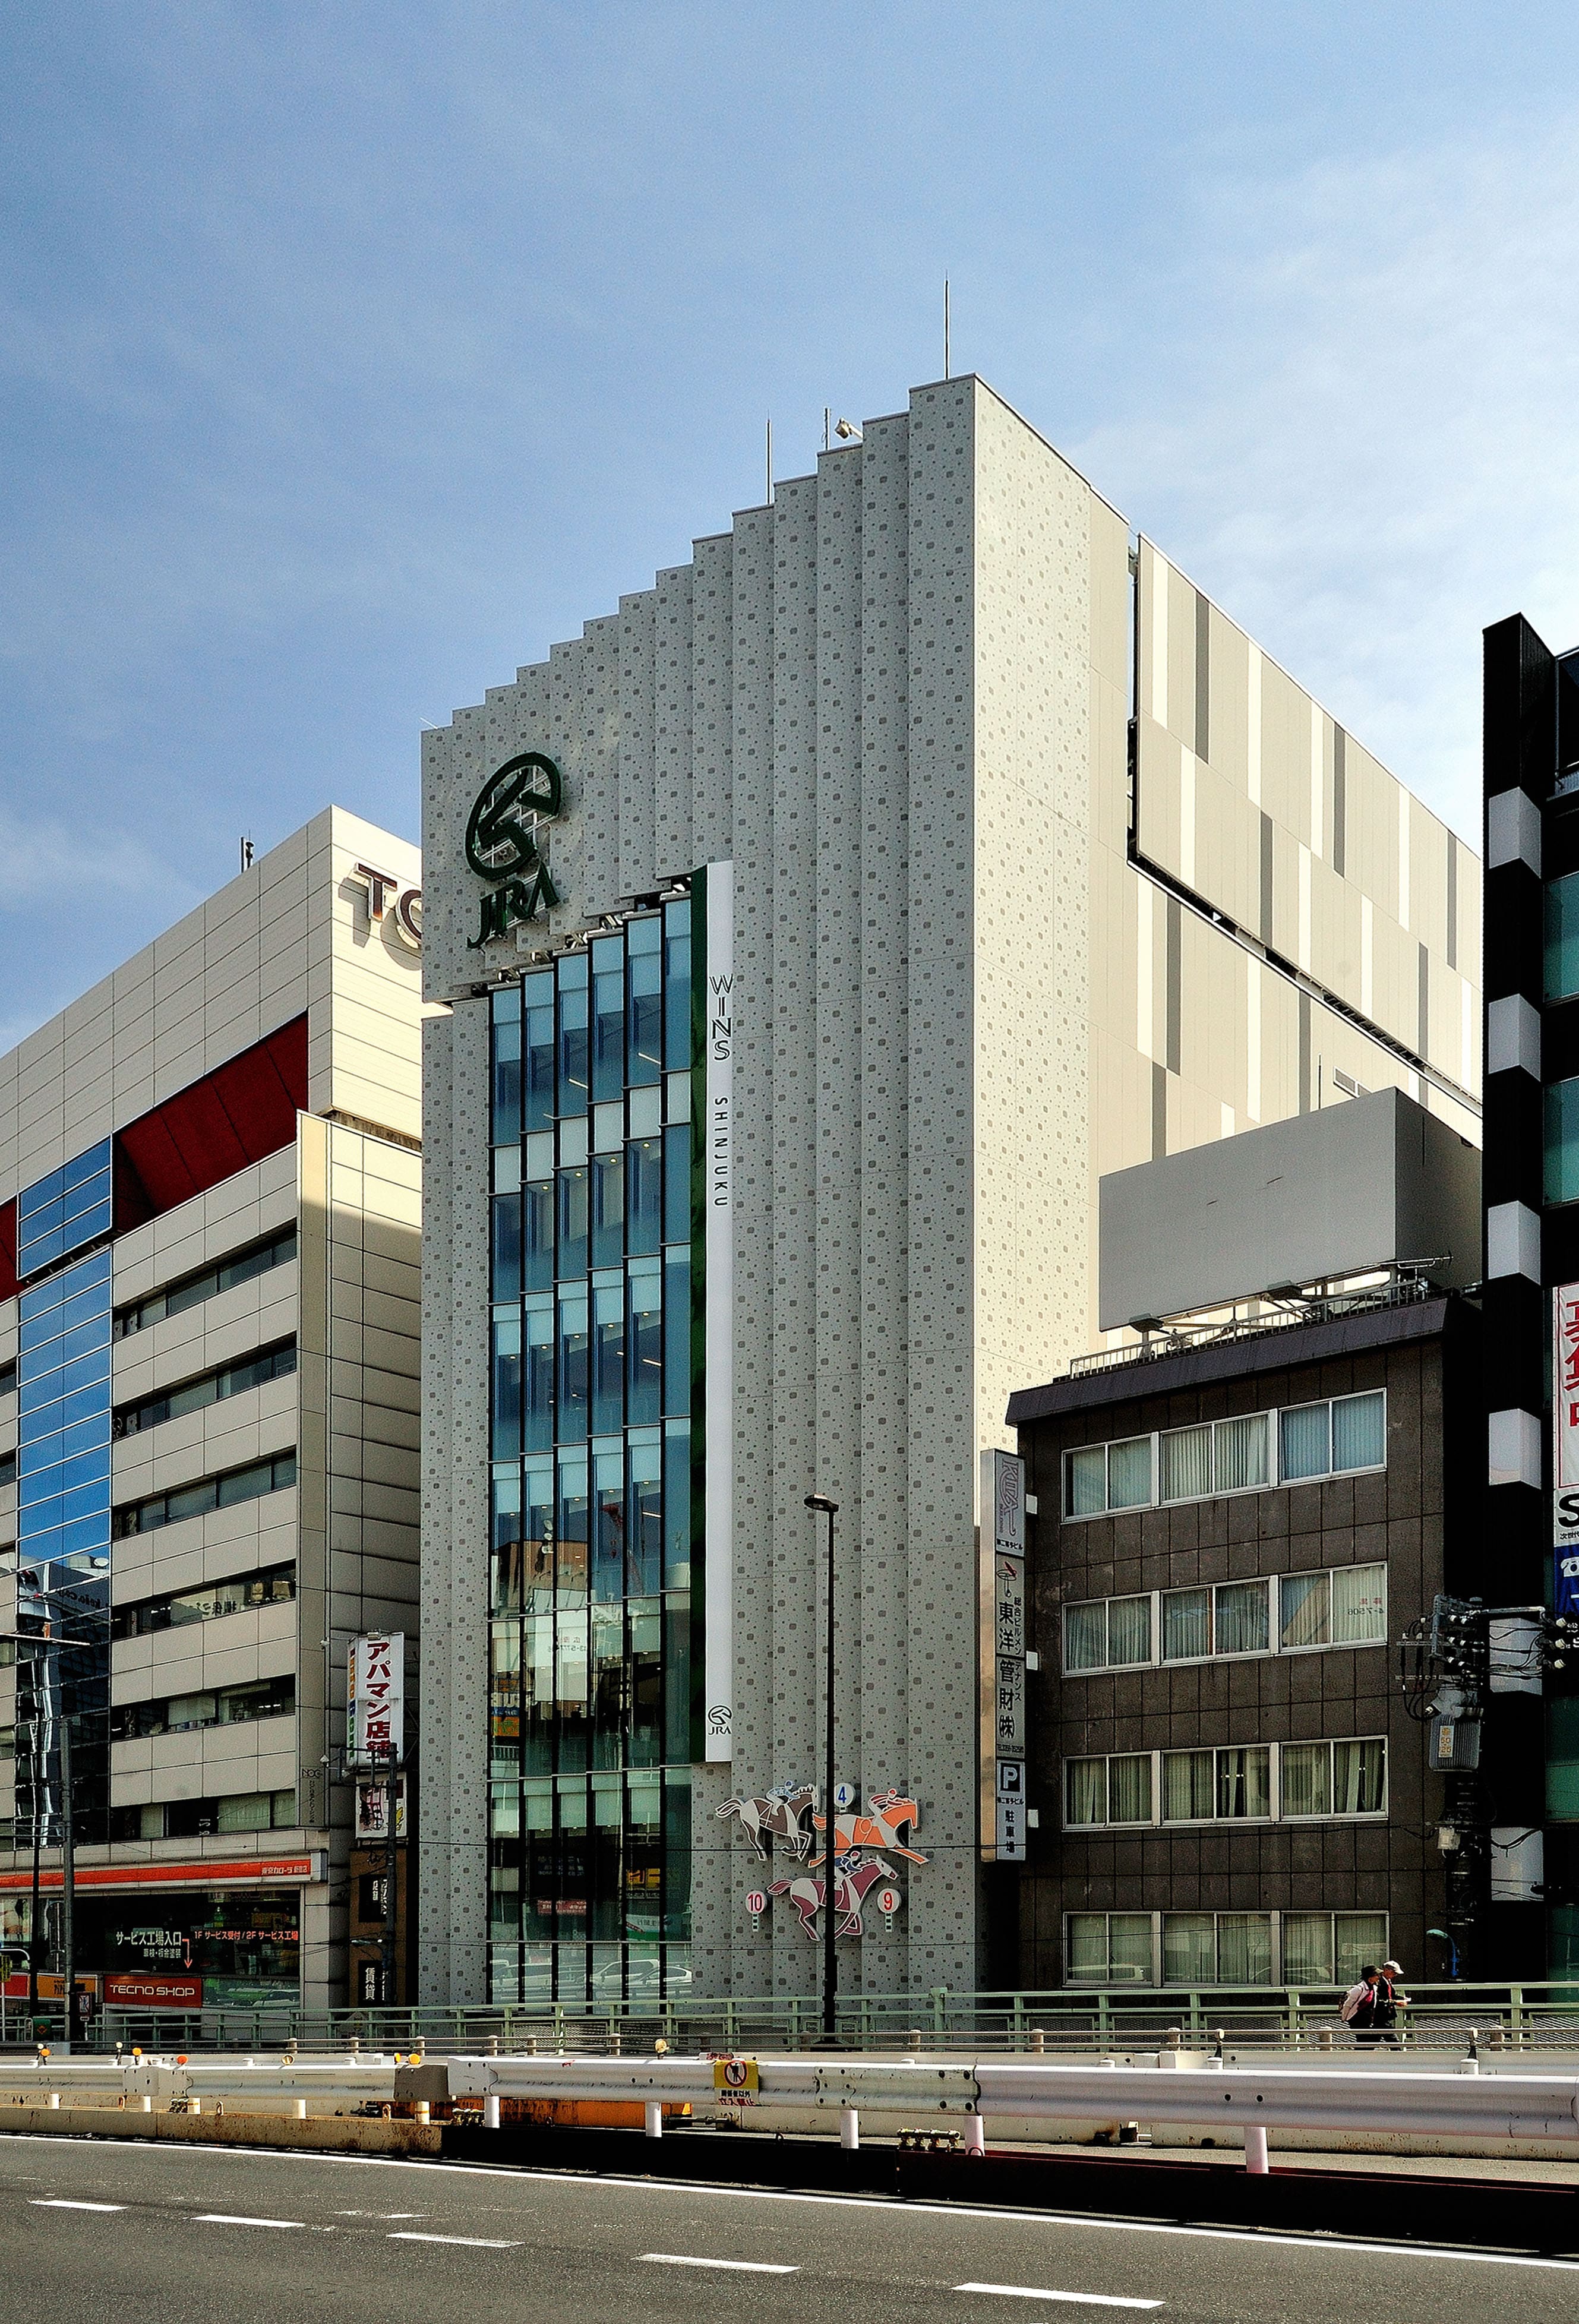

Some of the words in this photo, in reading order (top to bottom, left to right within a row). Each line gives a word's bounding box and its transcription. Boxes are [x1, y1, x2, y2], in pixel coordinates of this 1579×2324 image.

[468, 861, 560, 950] JRA
[709, 973, 734, 1061] WINS
[713, 1097, 728, 1207] SHINJUKU
[708, 1725, 732, 1735] JRA
[1003, 1766, 1018, 1789] P
[838, 1786, 847, 1804] 4
[1005, 1810, 1015, 1853] 駐車場
[747, 1893, 763, 1912] 10
[883, 1892, 892, 1911] 9
[116, 1930, 182, 1946] サービス工場入口
[109, 1985, 154, 1995] TECNO
[156, 1987, 195, 1997] SHOP
[365, 1968, 375, 2000] 賃貸
